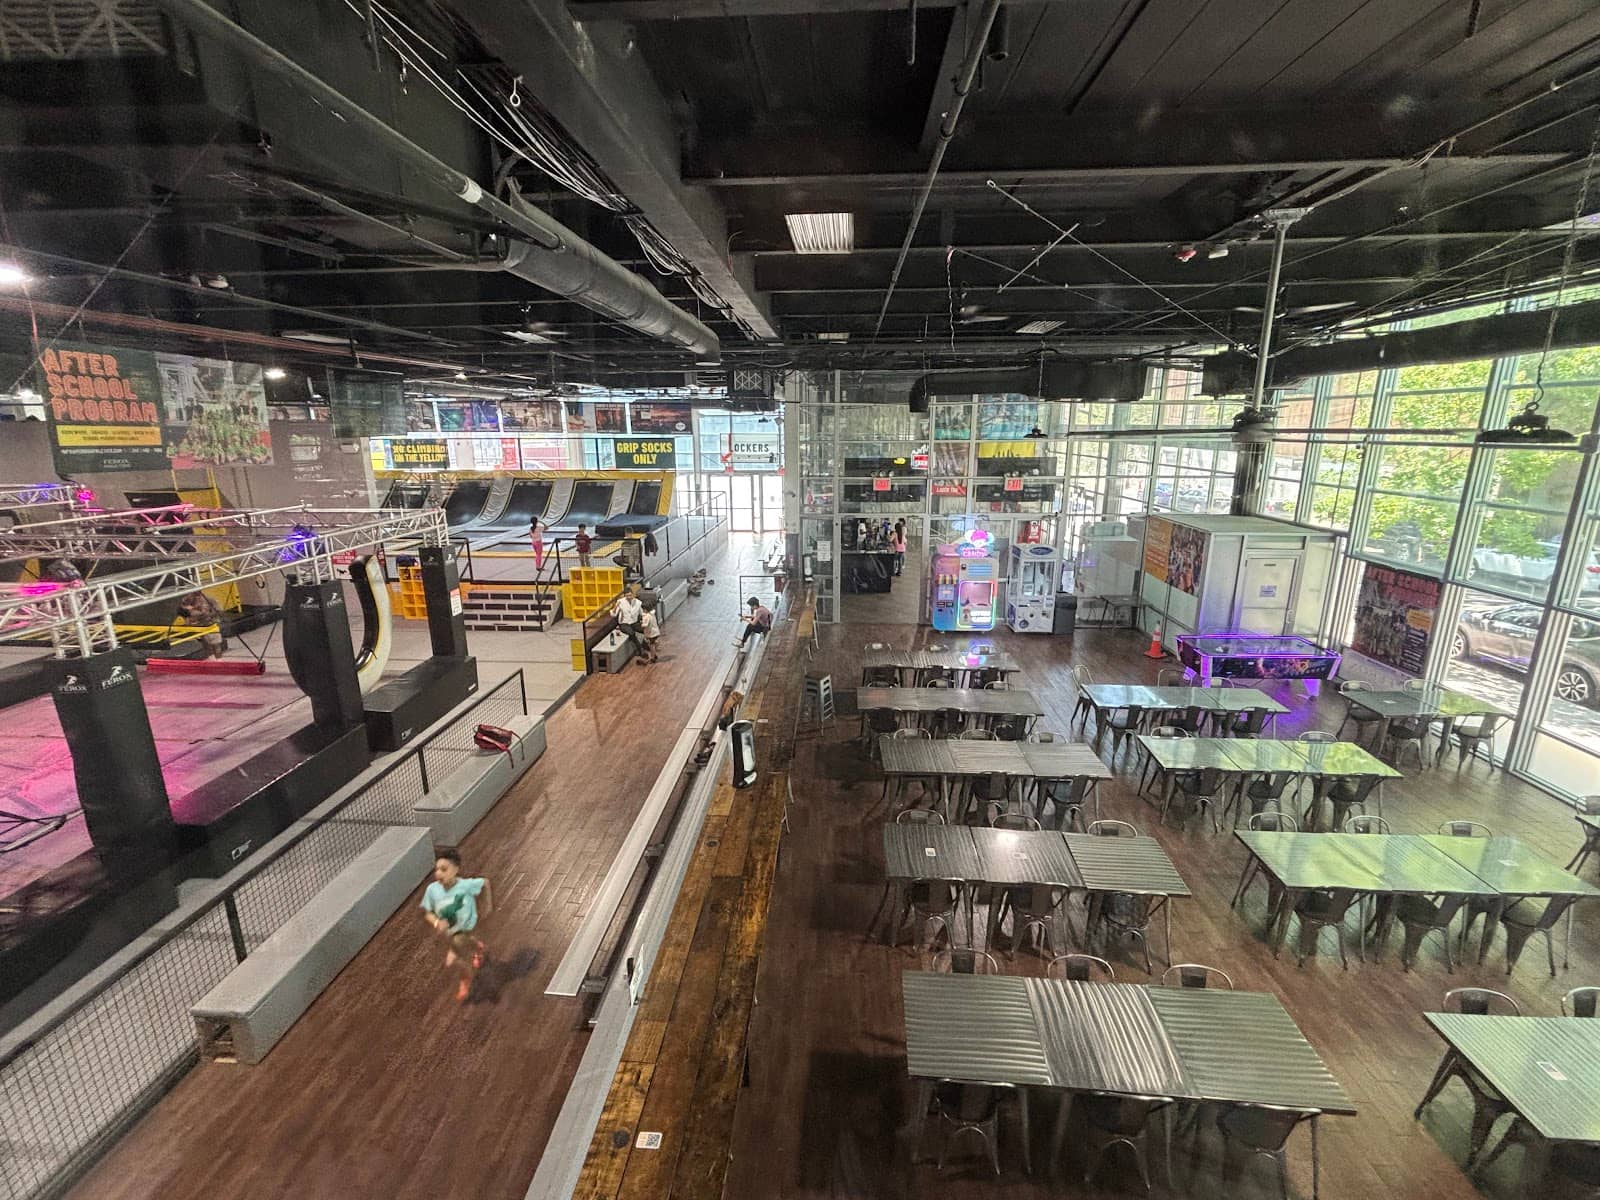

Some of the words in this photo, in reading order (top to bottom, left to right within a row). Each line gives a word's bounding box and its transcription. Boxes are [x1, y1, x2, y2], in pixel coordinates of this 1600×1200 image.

[43, 347, 119, 376] AFTER
[46, 373, 138, 400] SCHOOL
[53, 398, 157, 422] PROGRAM
[616, 441, 638, 453] GRIP
[640, 441, 673, 453] SOCKS
[405, 454, 418, 462] THE
[632, 454, 658, 465] ONLY
